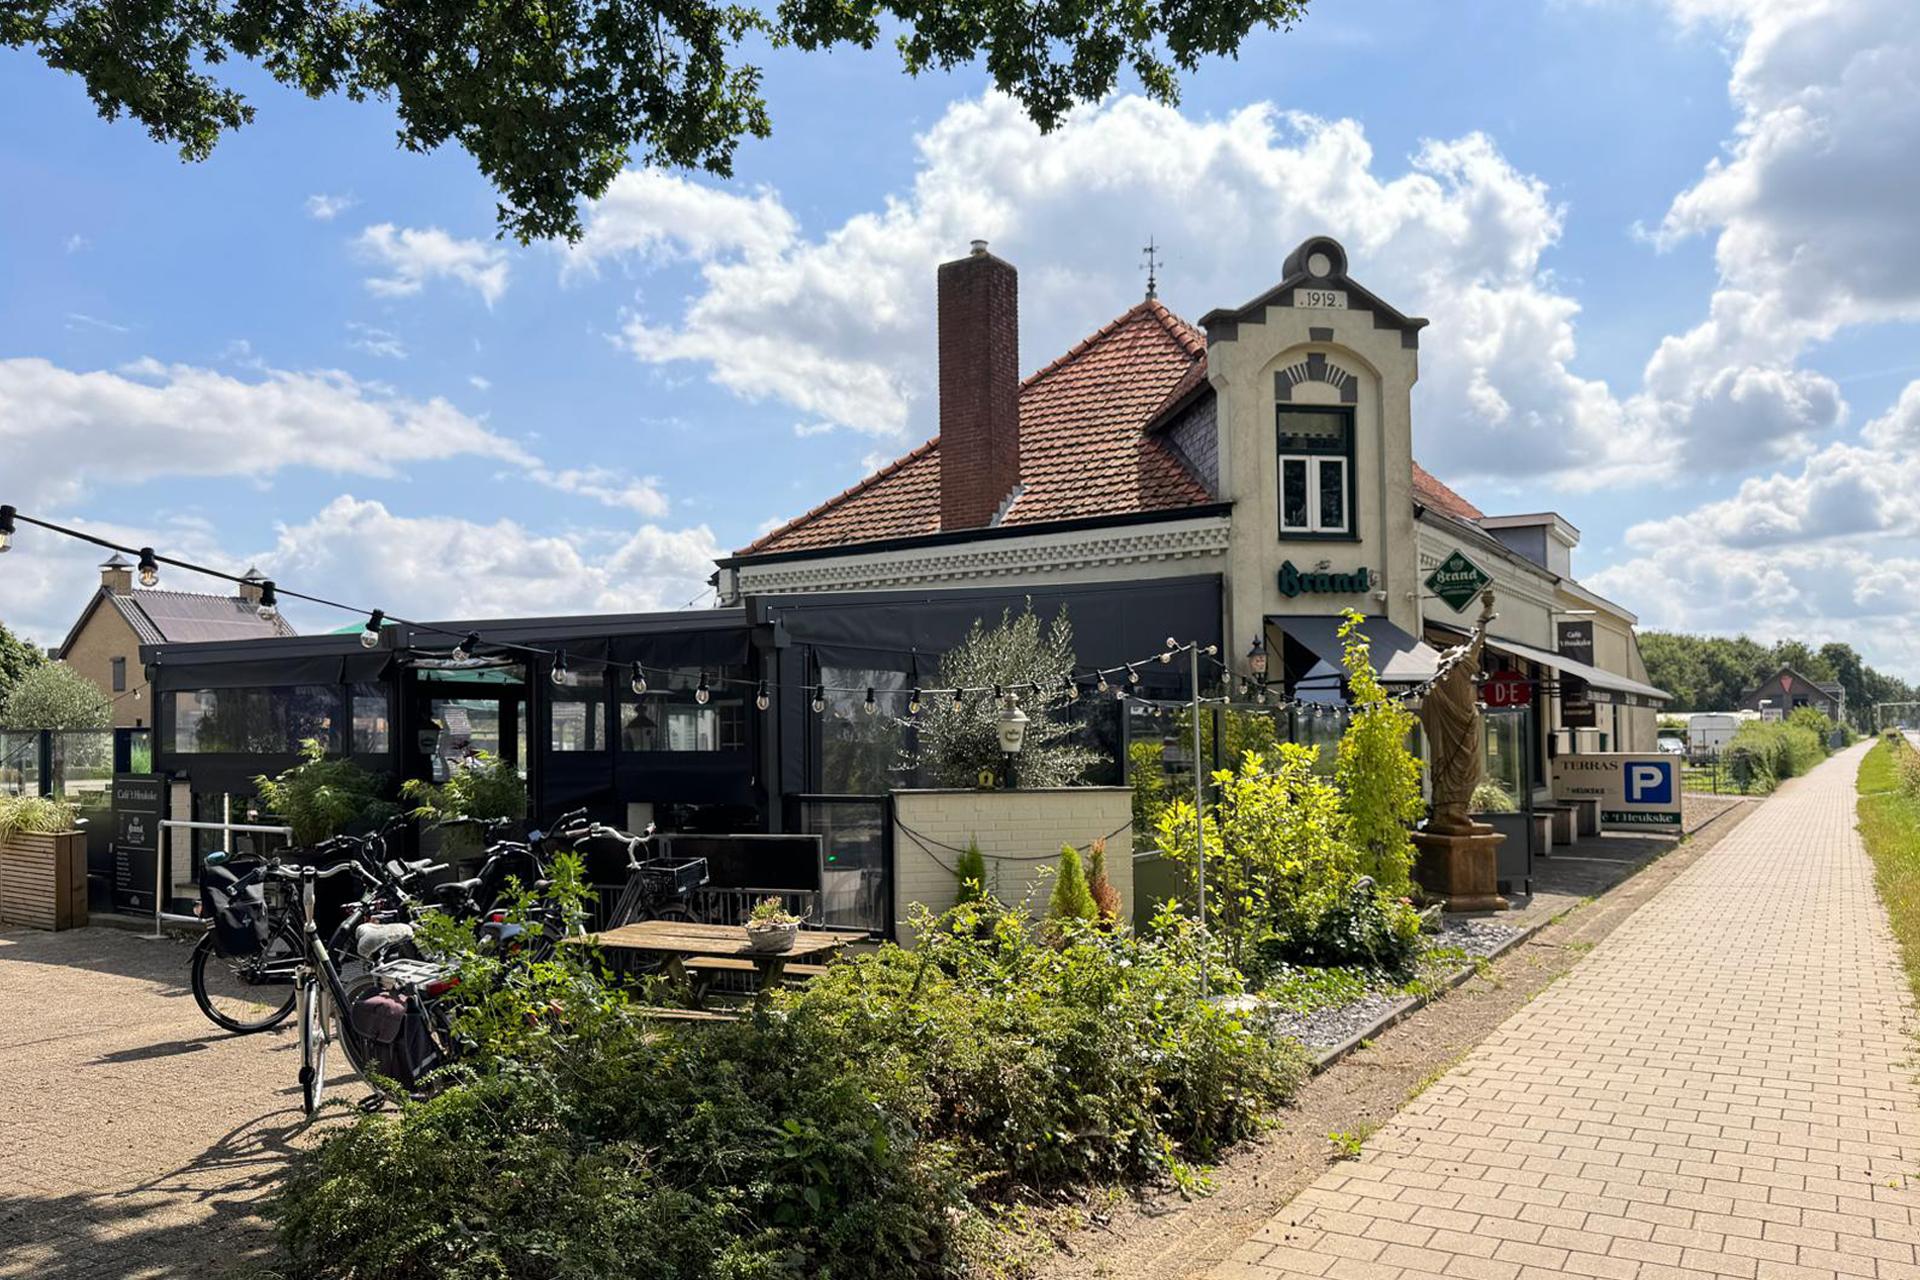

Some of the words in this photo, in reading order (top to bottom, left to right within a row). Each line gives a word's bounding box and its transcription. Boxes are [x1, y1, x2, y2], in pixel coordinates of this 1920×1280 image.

[1278, 559, 1370, 598] Brand
[1437, 569, 1477, 583] Brand
[1563, 761, 1618, 770] TERRAS
[1632, 766, 1663, 799] P
[1622, 813, 1673, 823] Heukske
